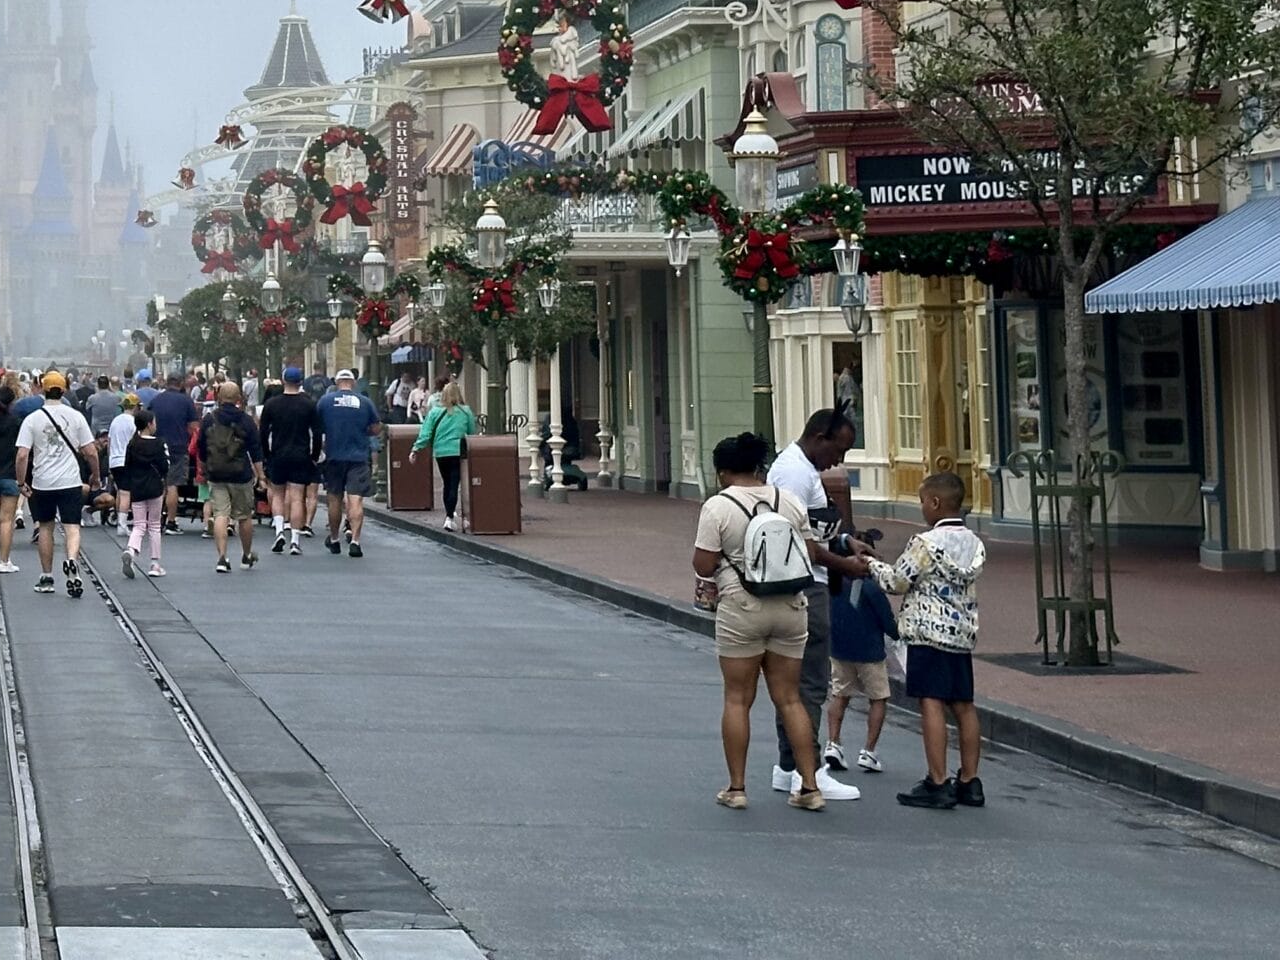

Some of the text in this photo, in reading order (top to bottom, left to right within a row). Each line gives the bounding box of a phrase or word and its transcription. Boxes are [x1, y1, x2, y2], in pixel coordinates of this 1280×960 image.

[976, 83, 1010, 97] AIN
[396, 120, 408, 218] CRYSTAL ARTS
[923, 157, 970, 176] NOW
[870, 183, 946, 204] MICKEY
